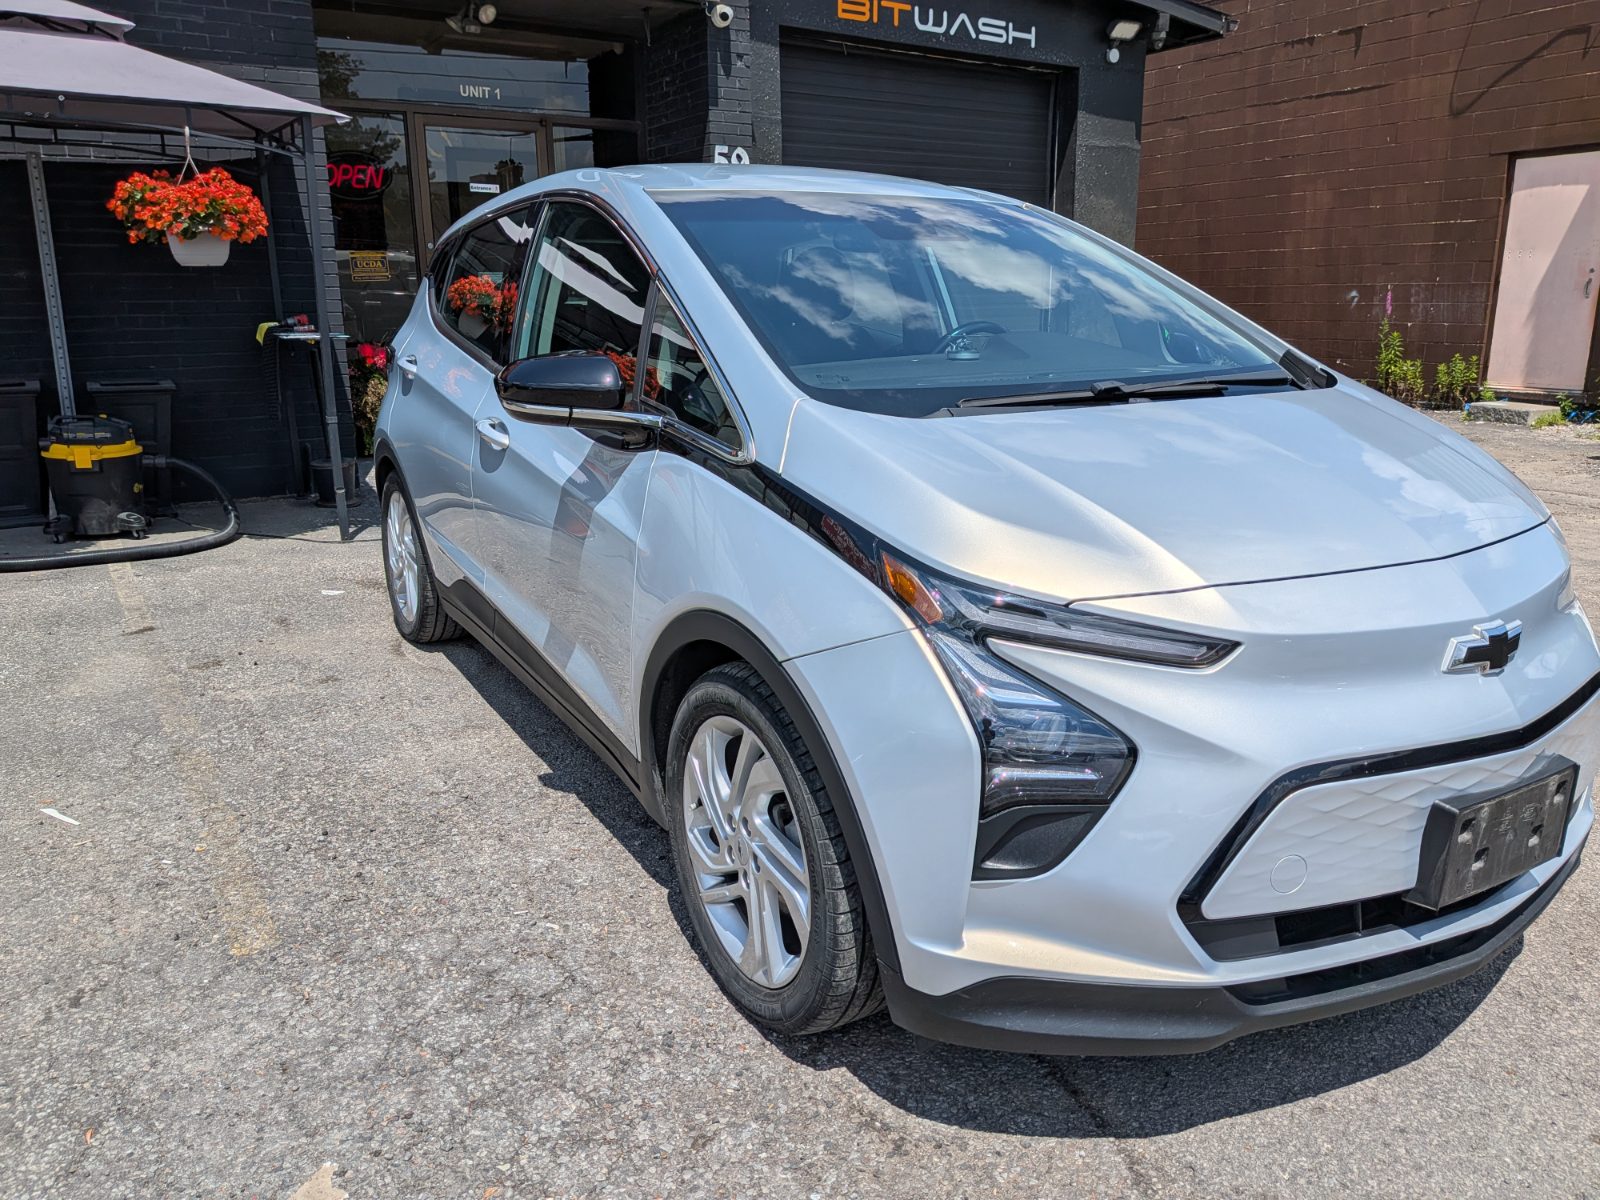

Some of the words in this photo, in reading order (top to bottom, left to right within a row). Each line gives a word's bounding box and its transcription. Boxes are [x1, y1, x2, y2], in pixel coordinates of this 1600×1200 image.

[459, 84, 491, 99] UNIT
[494, 87, 501, 100] 1
[325, 162, 385, 190] OPEN
[356, 260, 383, 268] UCDA
